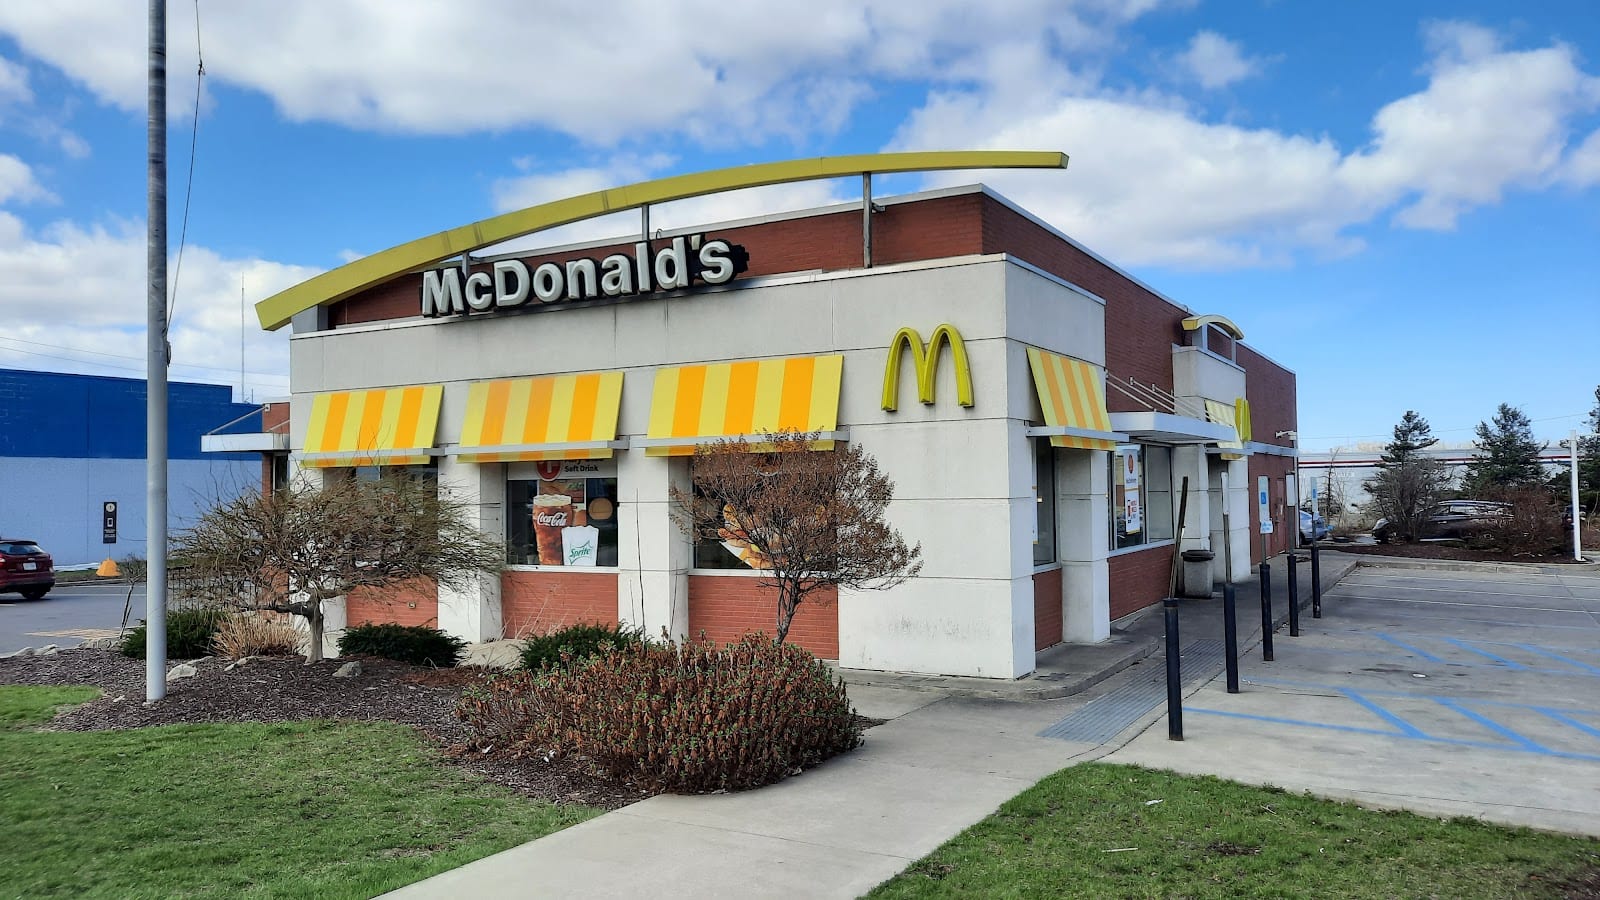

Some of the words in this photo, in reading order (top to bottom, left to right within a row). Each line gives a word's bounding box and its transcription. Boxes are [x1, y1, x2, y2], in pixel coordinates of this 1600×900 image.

[423, 233, 734, 316] McDonald's
[580, 464, 599, 472] Drink
[569, 547, 591, 558] Sprite
